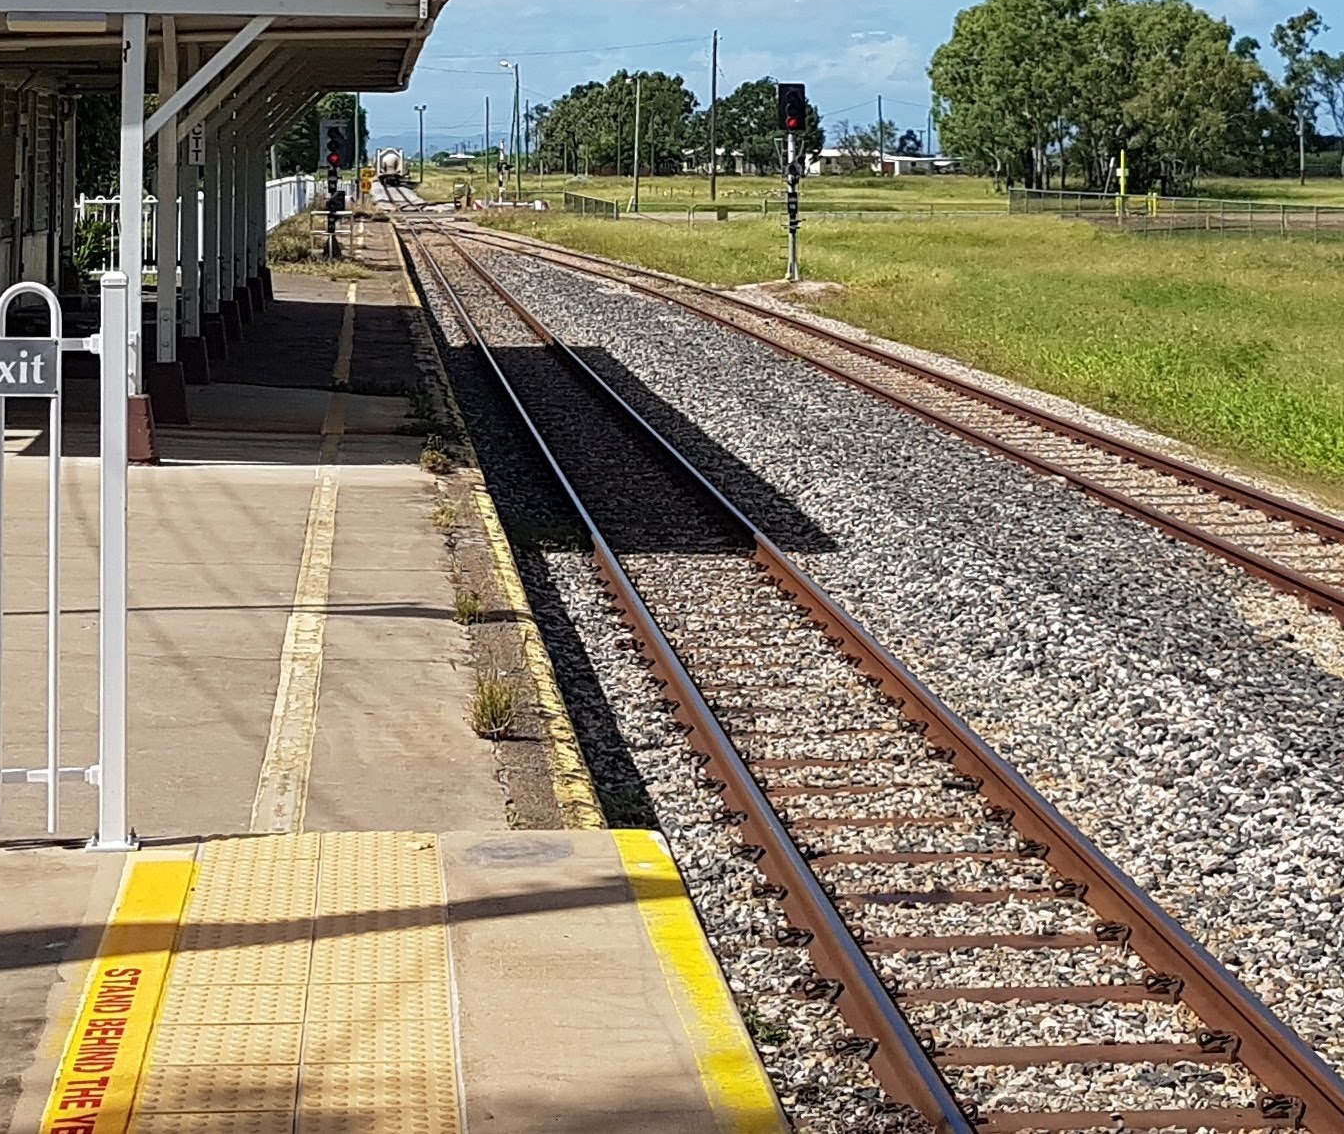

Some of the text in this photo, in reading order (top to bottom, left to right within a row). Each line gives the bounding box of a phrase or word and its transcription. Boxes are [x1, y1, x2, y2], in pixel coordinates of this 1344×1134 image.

[93, 968, 142, 1014] STAND
[73, 1018, 128, 1073] BEHIND
[59, 1076, 111, 1110] THE
